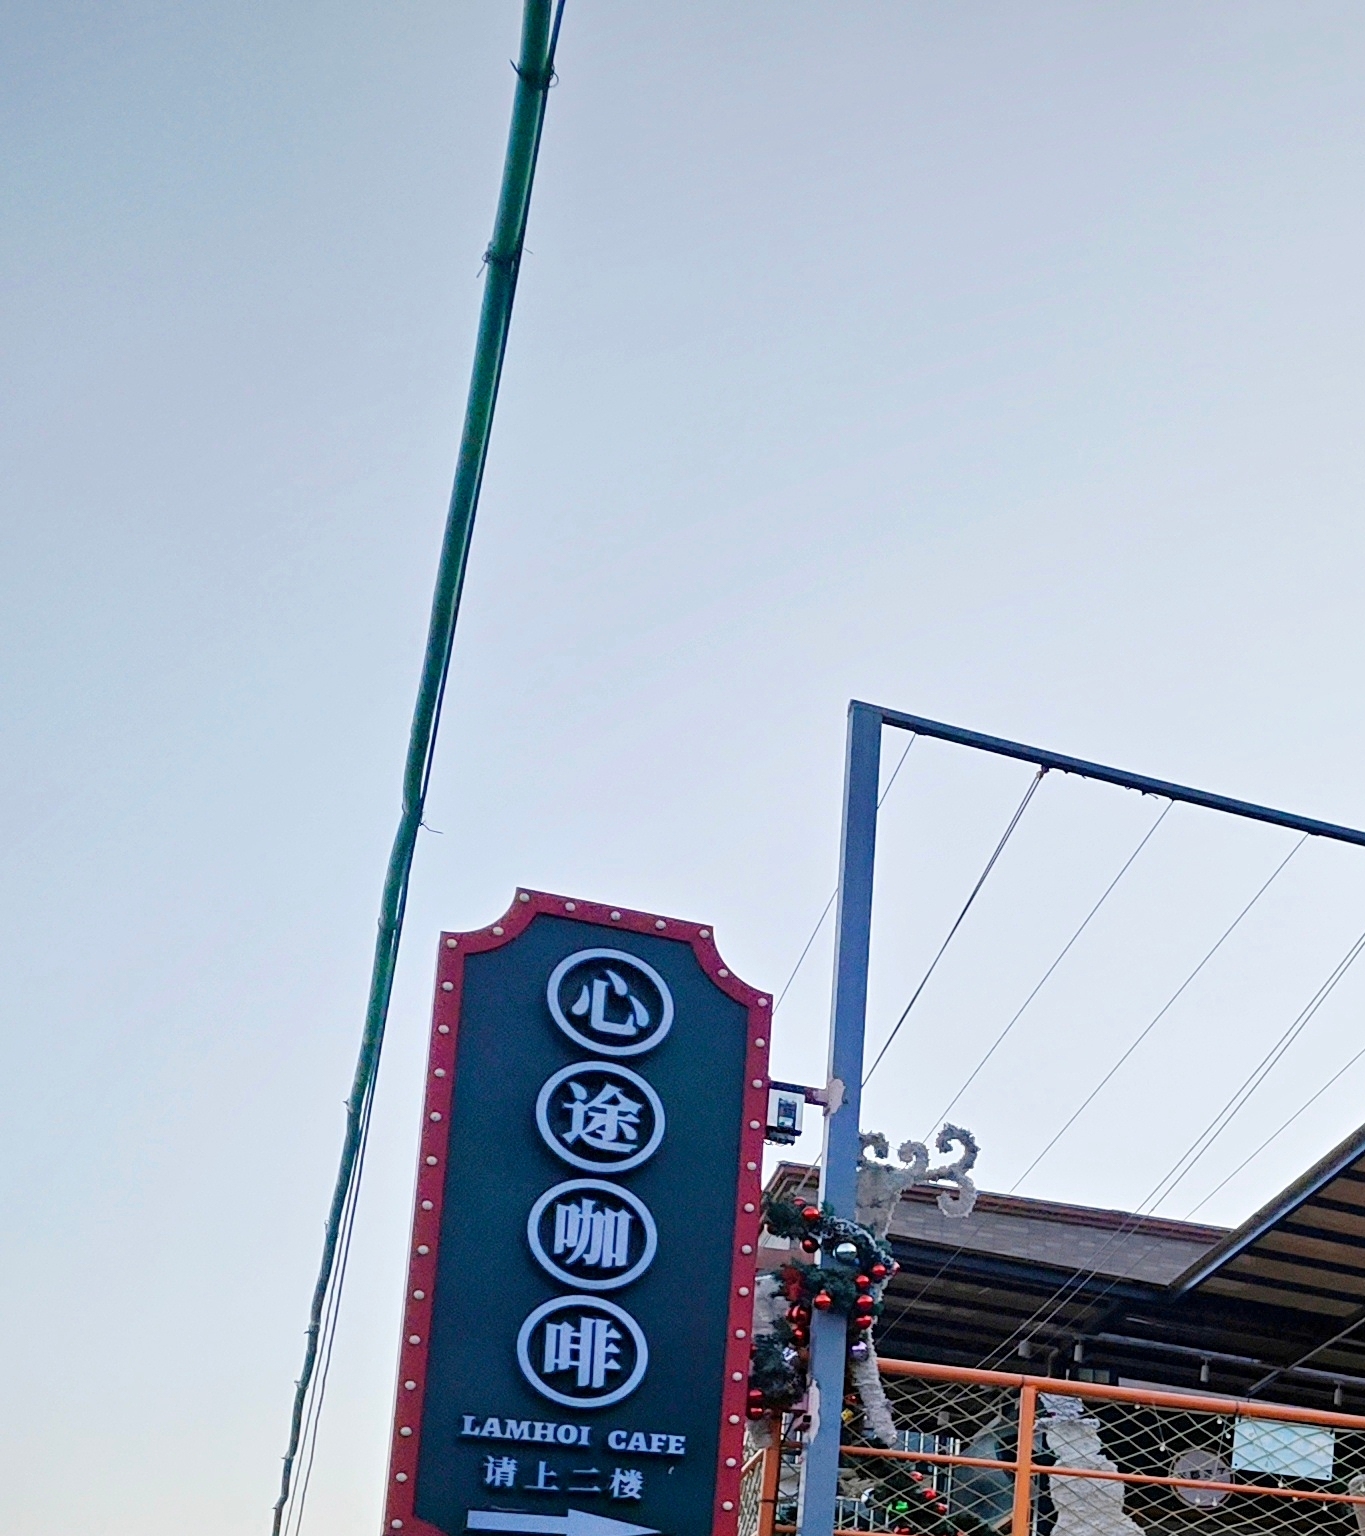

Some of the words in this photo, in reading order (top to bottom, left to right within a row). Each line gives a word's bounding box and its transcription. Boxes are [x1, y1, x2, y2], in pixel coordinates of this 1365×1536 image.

[544, 969, 649, 1388] 心途咖啡
[461, 1415, 591, 1446] LAMHOI
[607, 1430, 686, 1455] CAFE
[482, 1455, 644, 1499] 请上二楼
